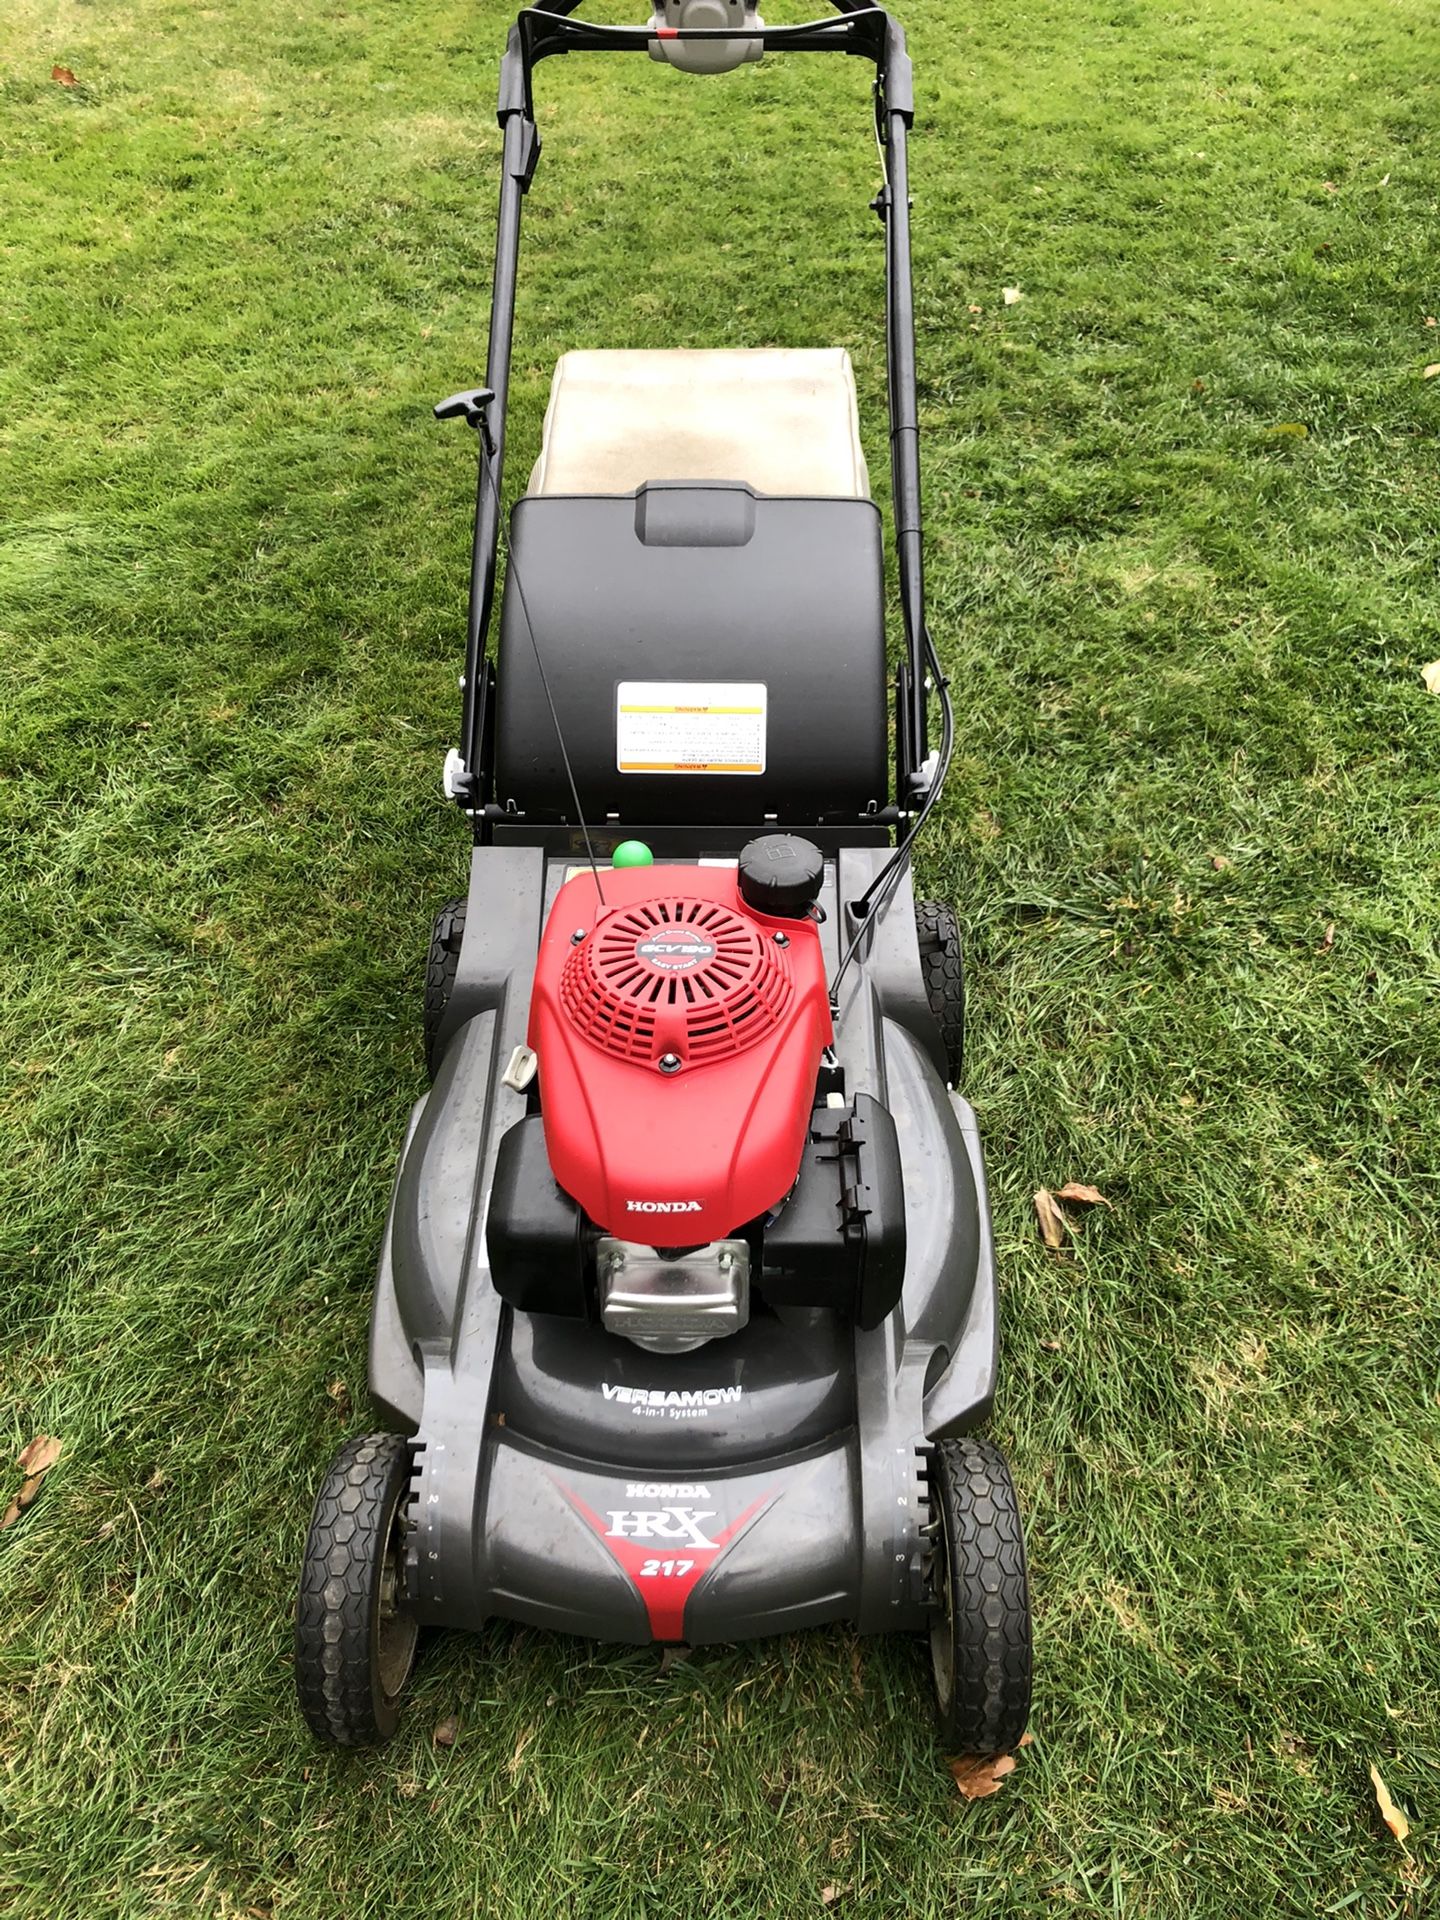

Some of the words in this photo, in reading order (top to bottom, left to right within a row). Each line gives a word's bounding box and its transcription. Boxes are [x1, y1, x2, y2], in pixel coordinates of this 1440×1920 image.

[627, 1200, 702, 1213] HONDA
[601, 1383, 742, 1407] VERSAMOW
[669, 1407, 708, 1420] System
[626, 1484, 711, 1498] HONDA
[897, 1496, 908, 1506] 2
[605, 1507, 721, 1549] HRX
[895, 1553, 906, 1562] 3
[640, 1559, 694, 1577] 217
